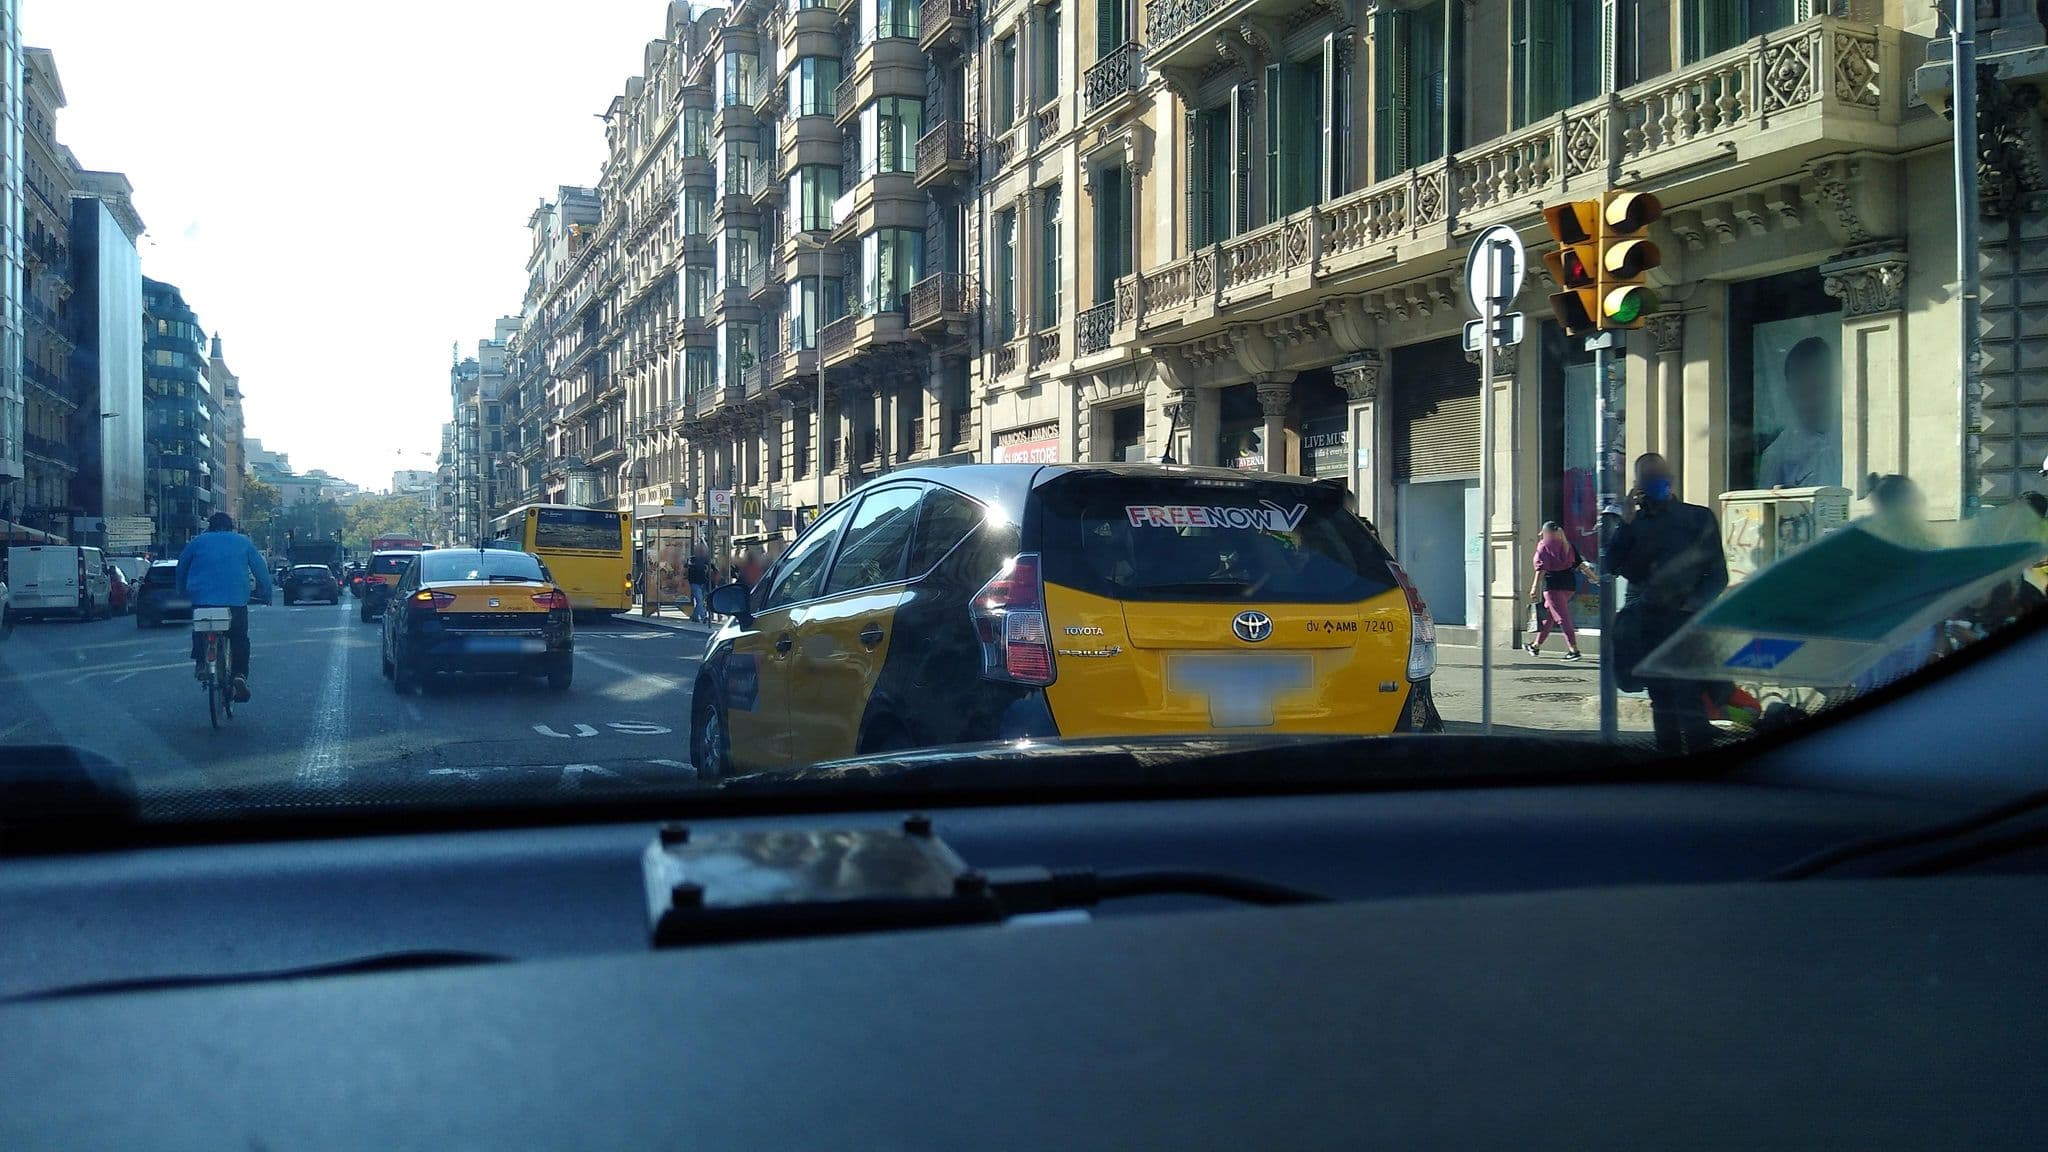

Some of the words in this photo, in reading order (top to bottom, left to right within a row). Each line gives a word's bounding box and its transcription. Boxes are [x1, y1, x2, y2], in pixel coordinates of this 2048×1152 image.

[1303, 434, 1326, 449] LIVE
[1004, 450, 1029, 464] SUPER
[1031, 446, 1057, 463] STORE
[1236, 455, 1265, 469] TAVERNA
[1064, 626, 1104, 636] TOYOTA
[1335, 621, 1358, 632] AMB
[1364, 620, 1394, 633] 7240
